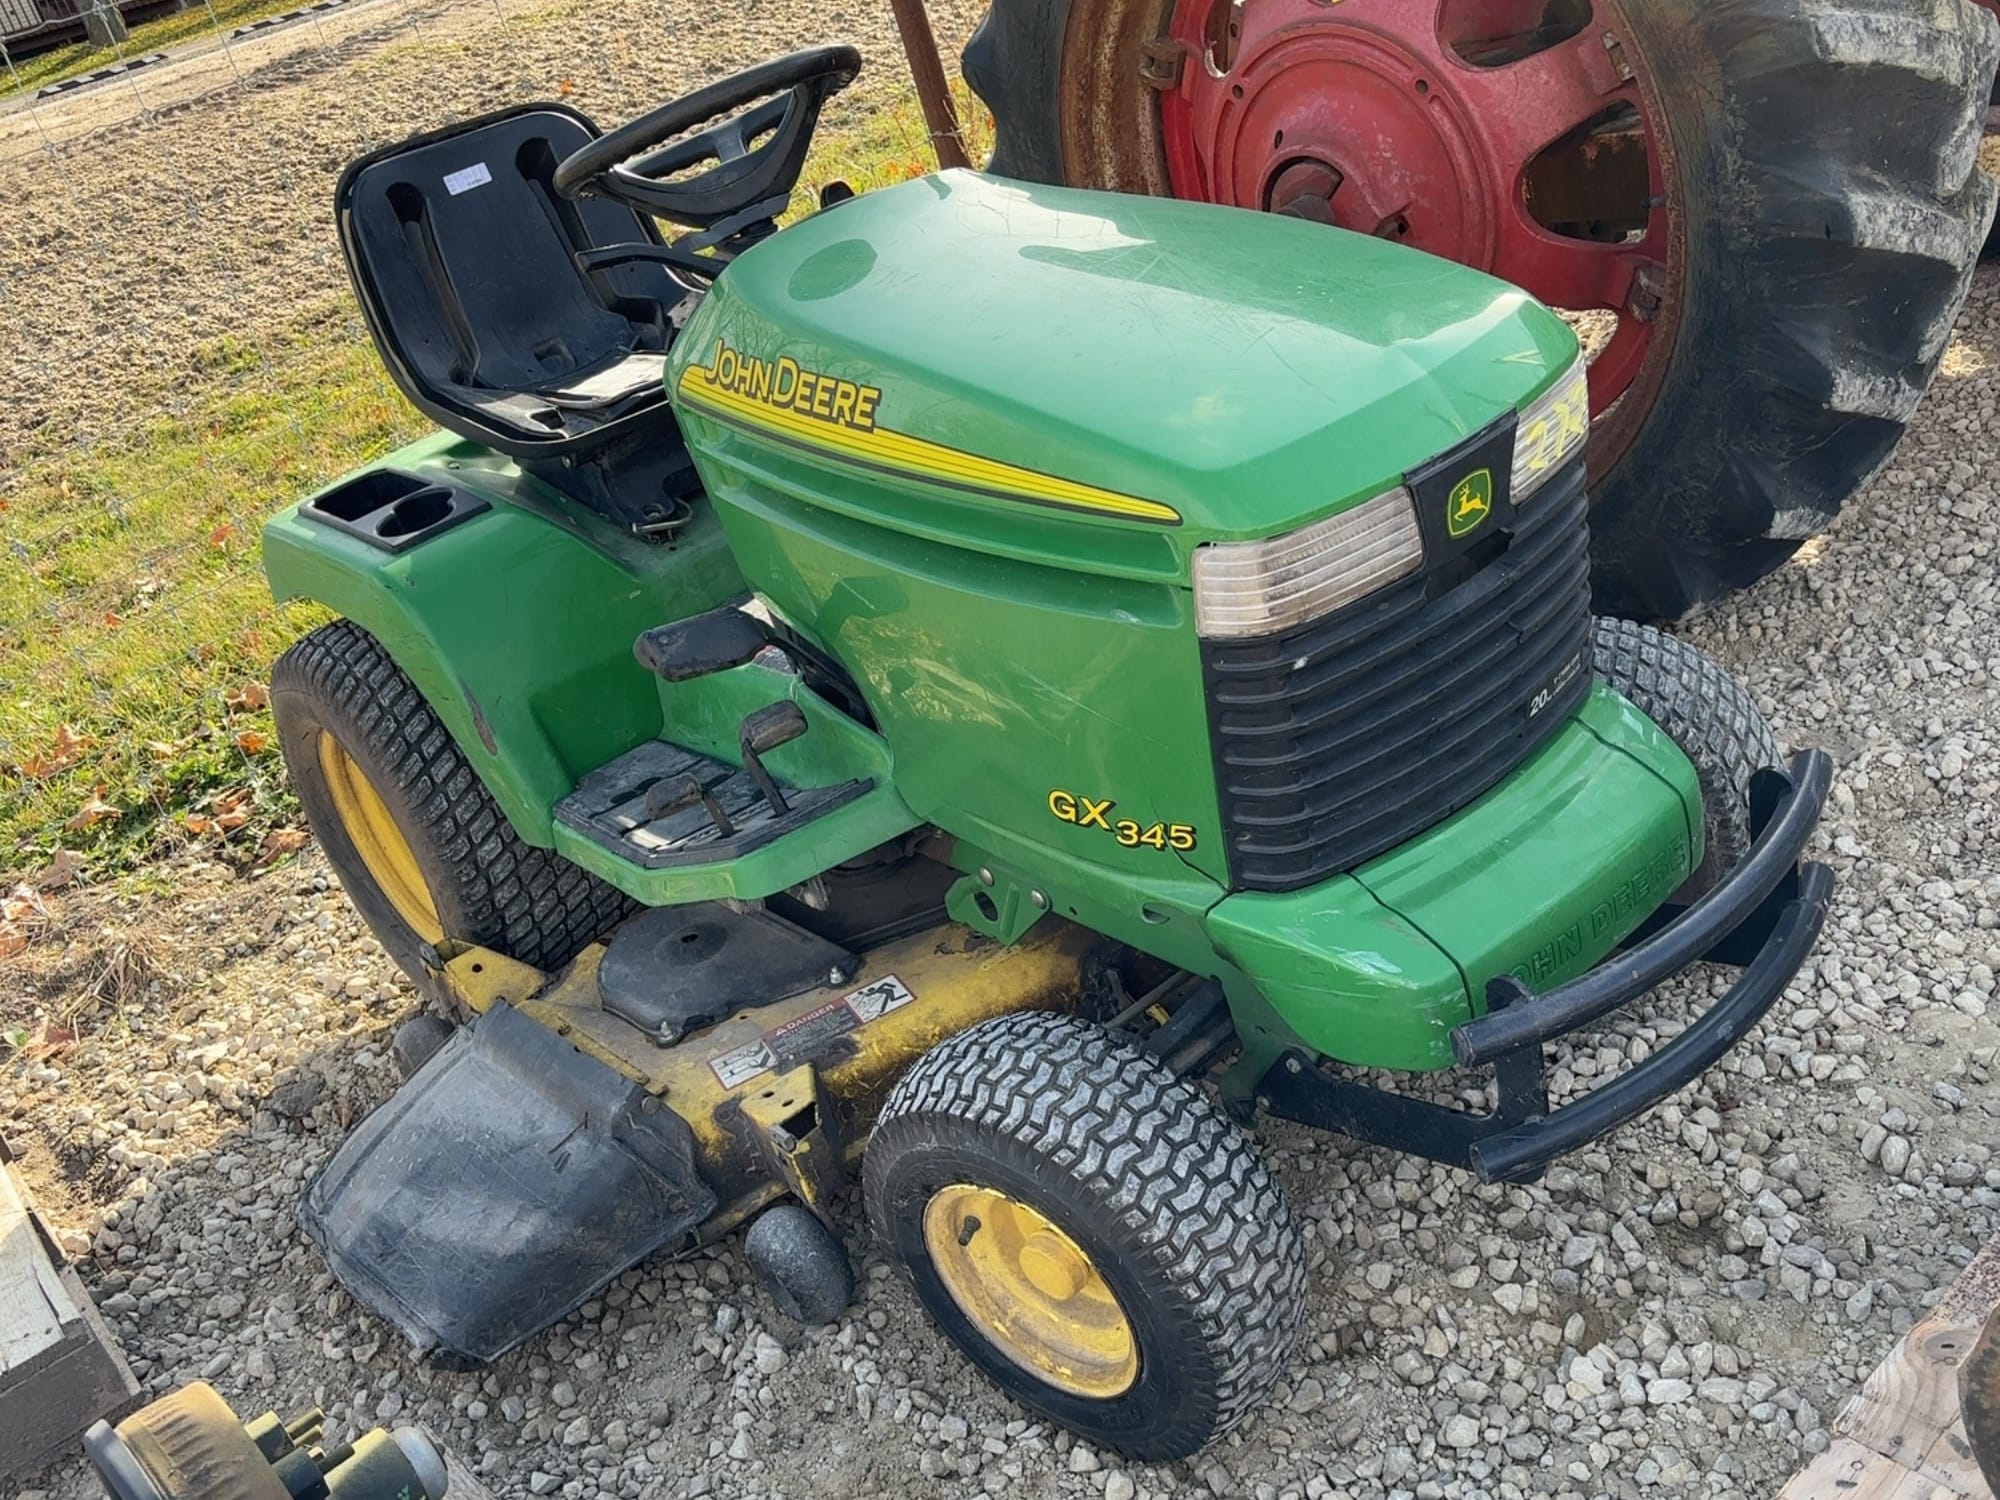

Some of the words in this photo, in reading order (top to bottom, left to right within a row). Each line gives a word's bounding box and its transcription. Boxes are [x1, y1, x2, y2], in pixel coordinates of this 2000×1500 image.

[704, 337, 774, 404] JOHN
[771, 355, 882, 434] DEERE
[1510, 922, 1583, 987] OHN
[1591, 833, 1686, 940] DEERE
[786, 1003, 836, 1031] DANGER
